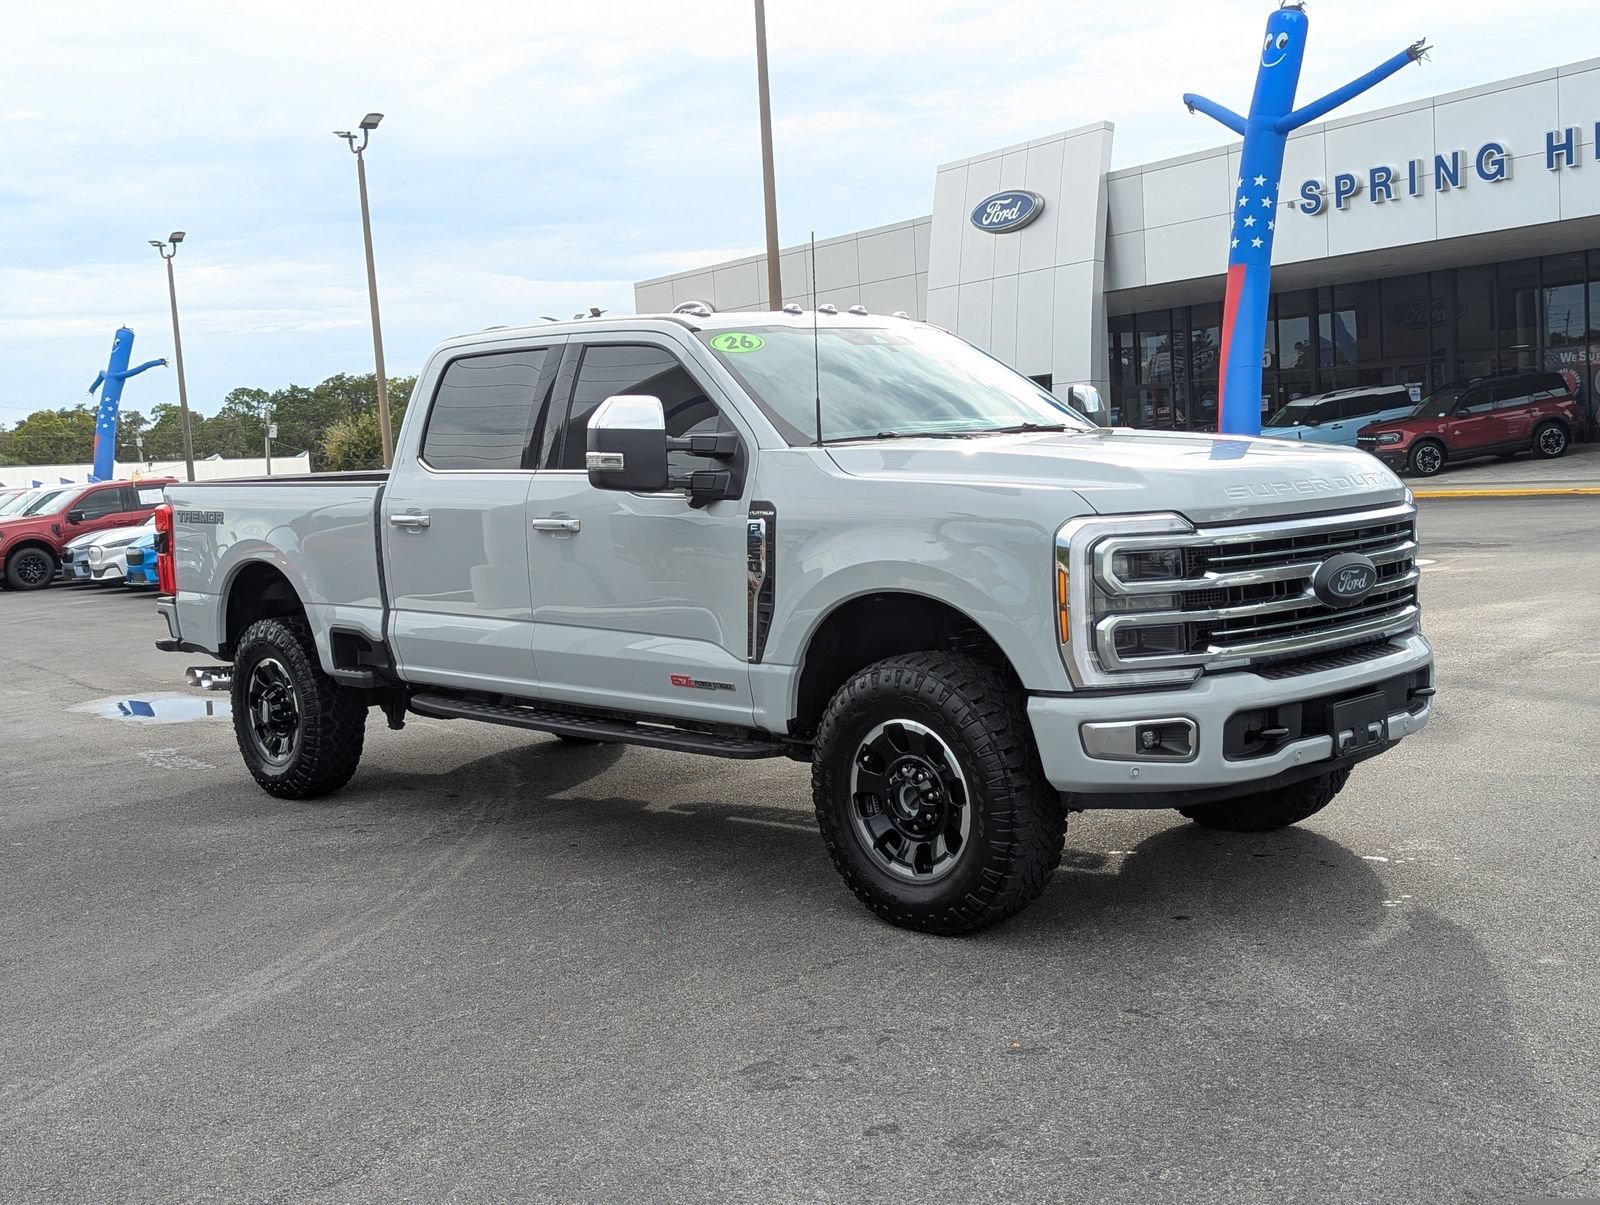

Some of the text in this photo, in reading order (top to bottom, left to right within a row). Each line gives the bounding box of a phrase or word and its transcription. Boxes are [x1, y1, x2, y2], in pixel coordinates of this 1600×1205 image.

[1299, 141, 1511, 217] SPRING
[982, 198, 1022, 225] Ford
[724, 335, 754, 350] 26
[1224, 471, 1391, 500] SUPER DUTY
[177, 510, 225, 525] TREMOR
[1337, 569, 1368, 593] Ford
